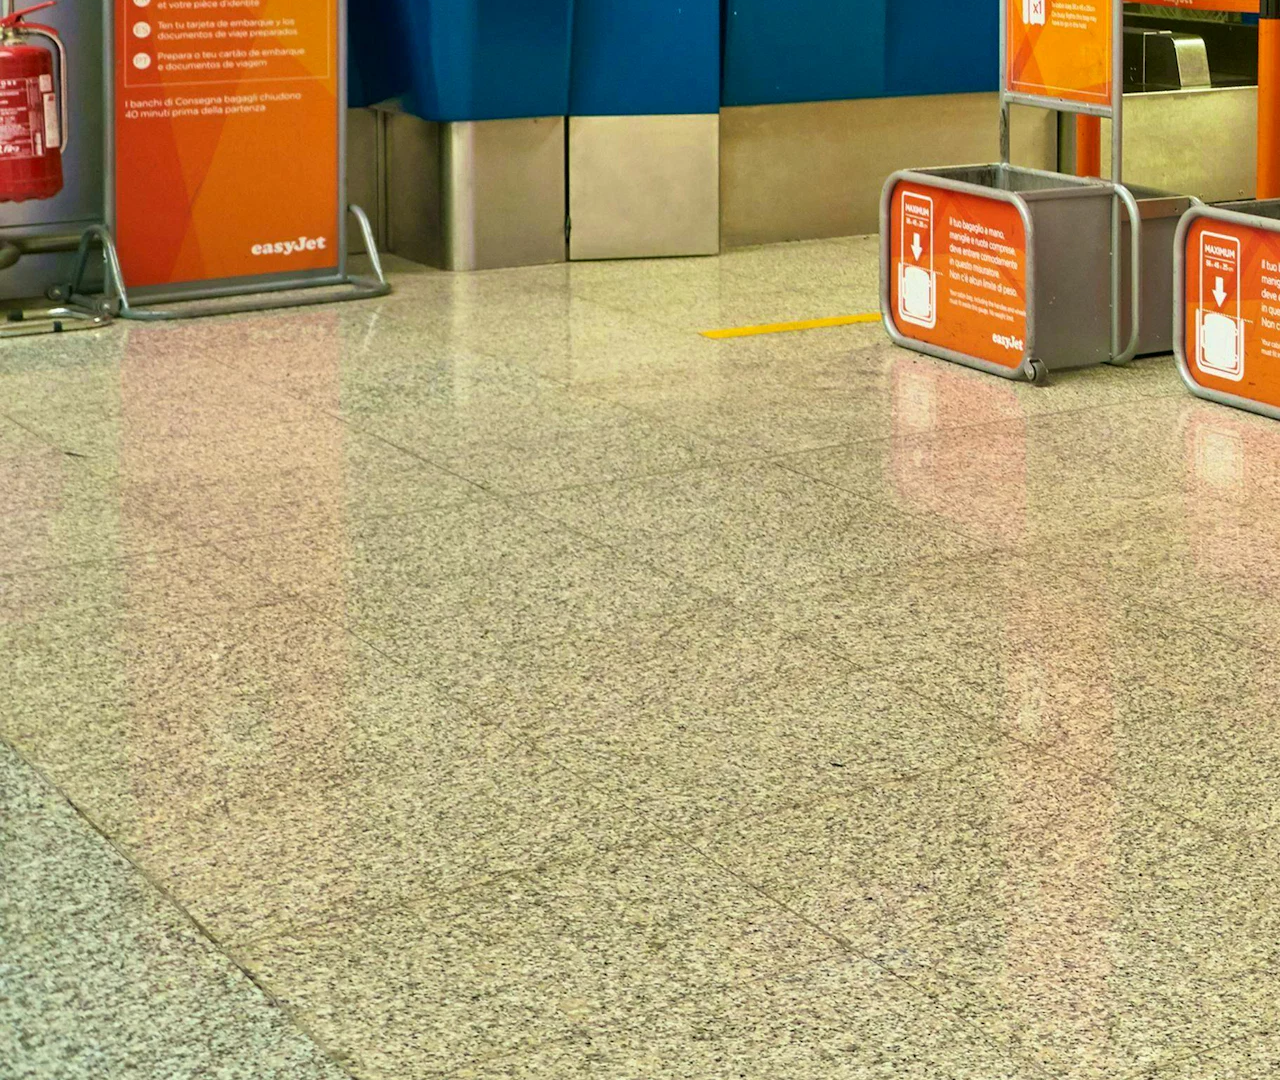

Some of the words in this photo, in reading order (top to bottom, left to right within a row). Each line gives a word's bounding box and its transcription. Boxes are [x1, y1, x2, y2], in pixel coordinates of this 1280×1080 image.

[131, 98, 162, 108] banchi
[164, 98, 173, 106] di
[175, 95, 222, 107] Consegna
[259, 91, 301, 102] chiudono
[251, 236, 326, 256] easyJet
[1205, 244, 1235, 258] MAXIMUM
[992, 332, 1023, 351] easyJet
